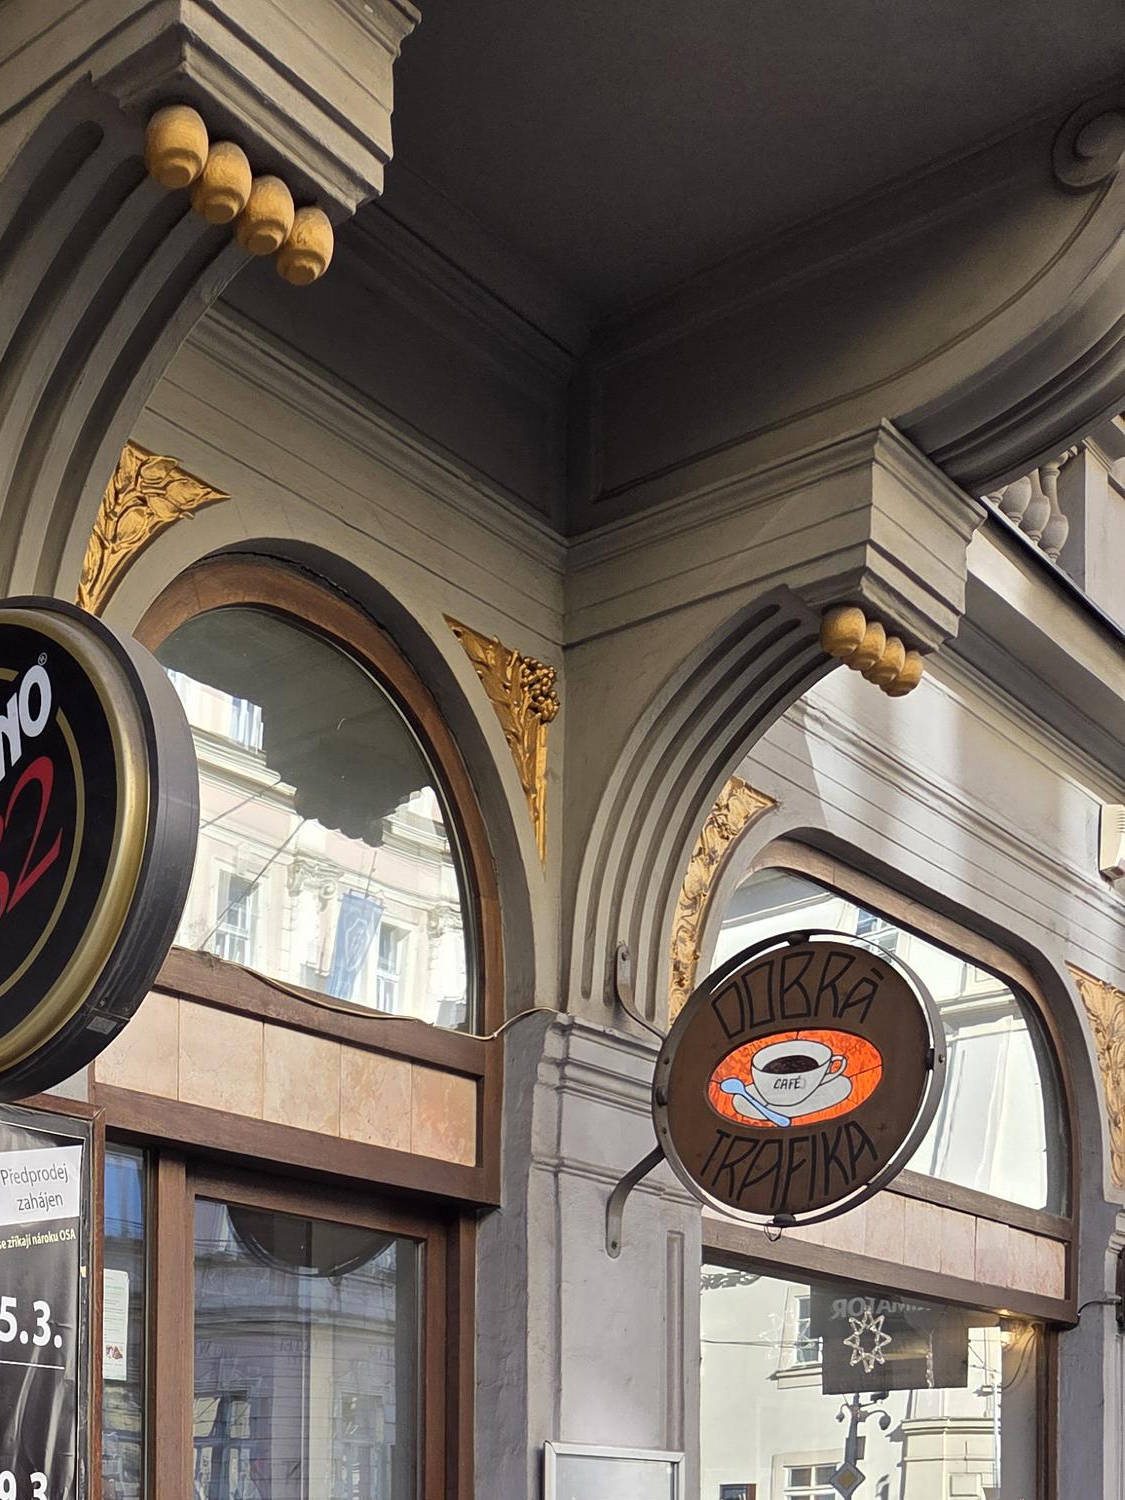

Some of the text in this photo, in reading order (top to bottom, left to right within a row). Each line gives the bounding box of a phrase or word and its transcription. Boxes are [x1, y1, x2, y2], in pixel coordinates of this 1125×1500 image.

[773, 1076, 802, 1089] CAFÉ
[700, 1121, 878, 1209] TRAFIKA
[0, 1164, 69, 1187] Předprodej
[16, 1192, 64, 1212] zahájen
[7, 1234, 31, 1248] zříkají
[32, 1231, 59, 1245] nároku
[59, 1228, 76, 1240] OSA
